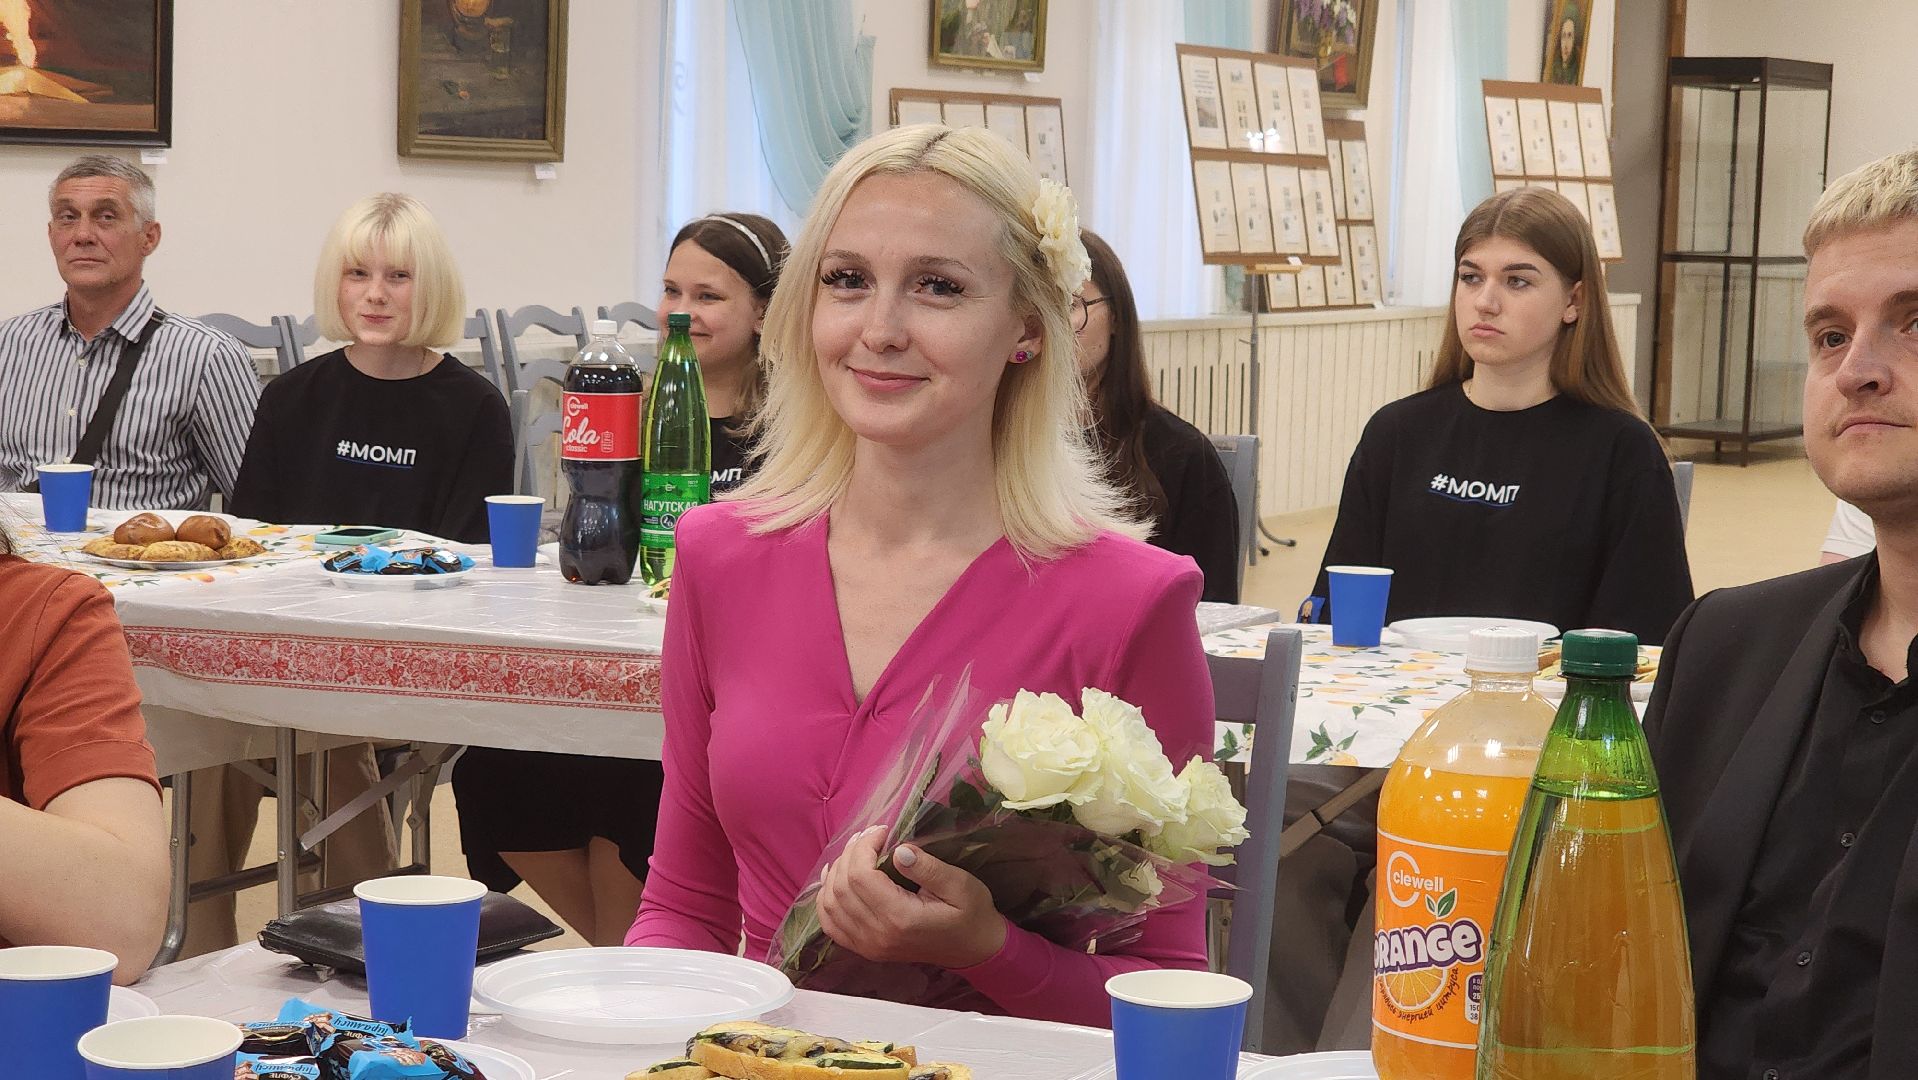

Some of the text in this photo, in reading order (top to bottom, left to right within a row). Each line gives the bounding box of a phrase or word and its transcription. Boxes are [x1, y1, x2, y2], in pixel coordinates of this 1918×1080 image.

[563, 416, 601, 445] Cola
[336, 439, 417, 465] #МОМП
[1430, 473, 1520, 504] #МОМП
[1392, 869, 1444, 893] clewell
[1398, 1006, 1434, 1024] энергией
[1436, 967, 1460, 1011] цитруса
[333, 1016, 389, 1038] Тирамису
[255, 1062, 318, 1076] Тирамису
